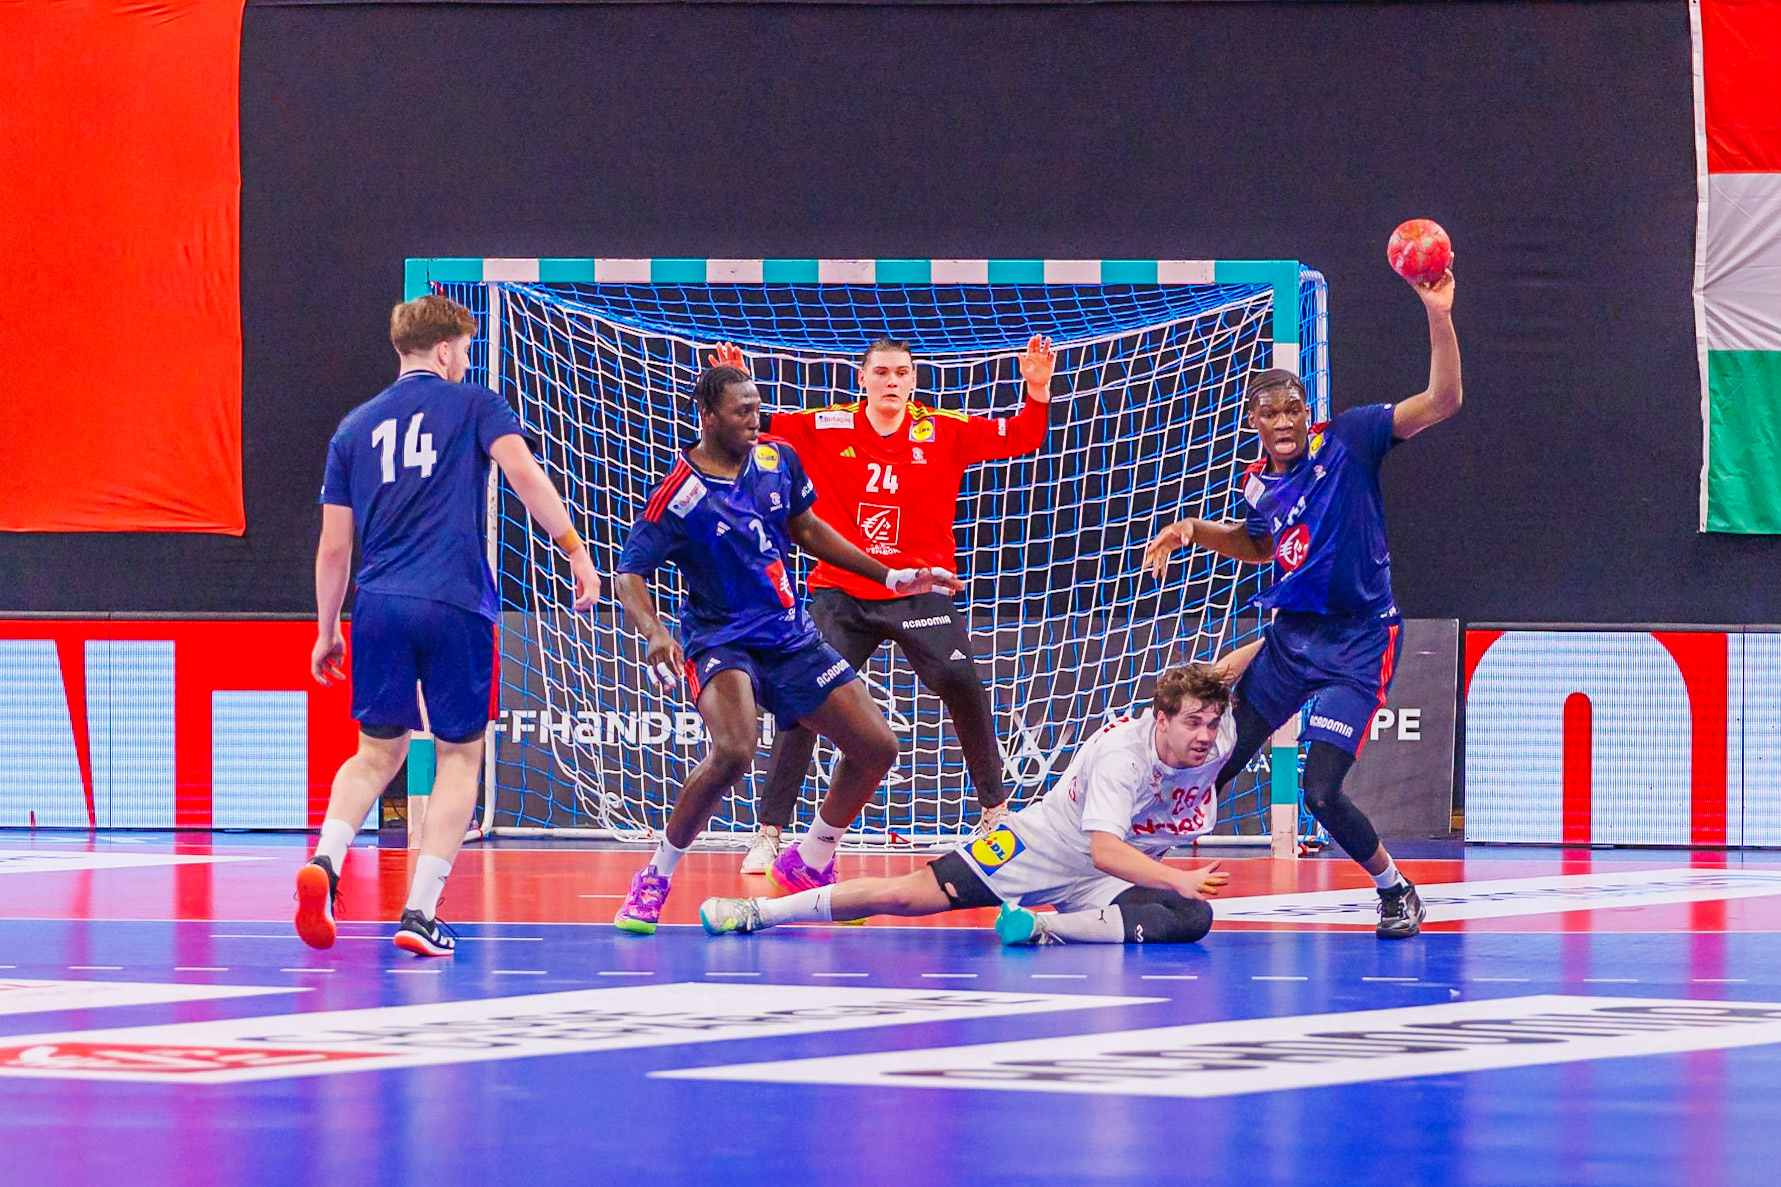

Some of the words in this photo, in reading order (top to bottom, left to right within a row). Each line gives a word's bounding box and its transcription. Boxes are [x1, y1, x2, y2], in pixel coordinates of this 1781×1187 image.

[371, 411, 437, 483] 14
[865, 463, 899, 494] 24
[749, 518, 773, 554] 2
[902, 615, 951, 630] ACADOMIA
[816, 658, 851, 688] ACADOM
[1171, 786, 1199, 816] 26
[880, 1005, 1781, 1082] ACADOMIA
